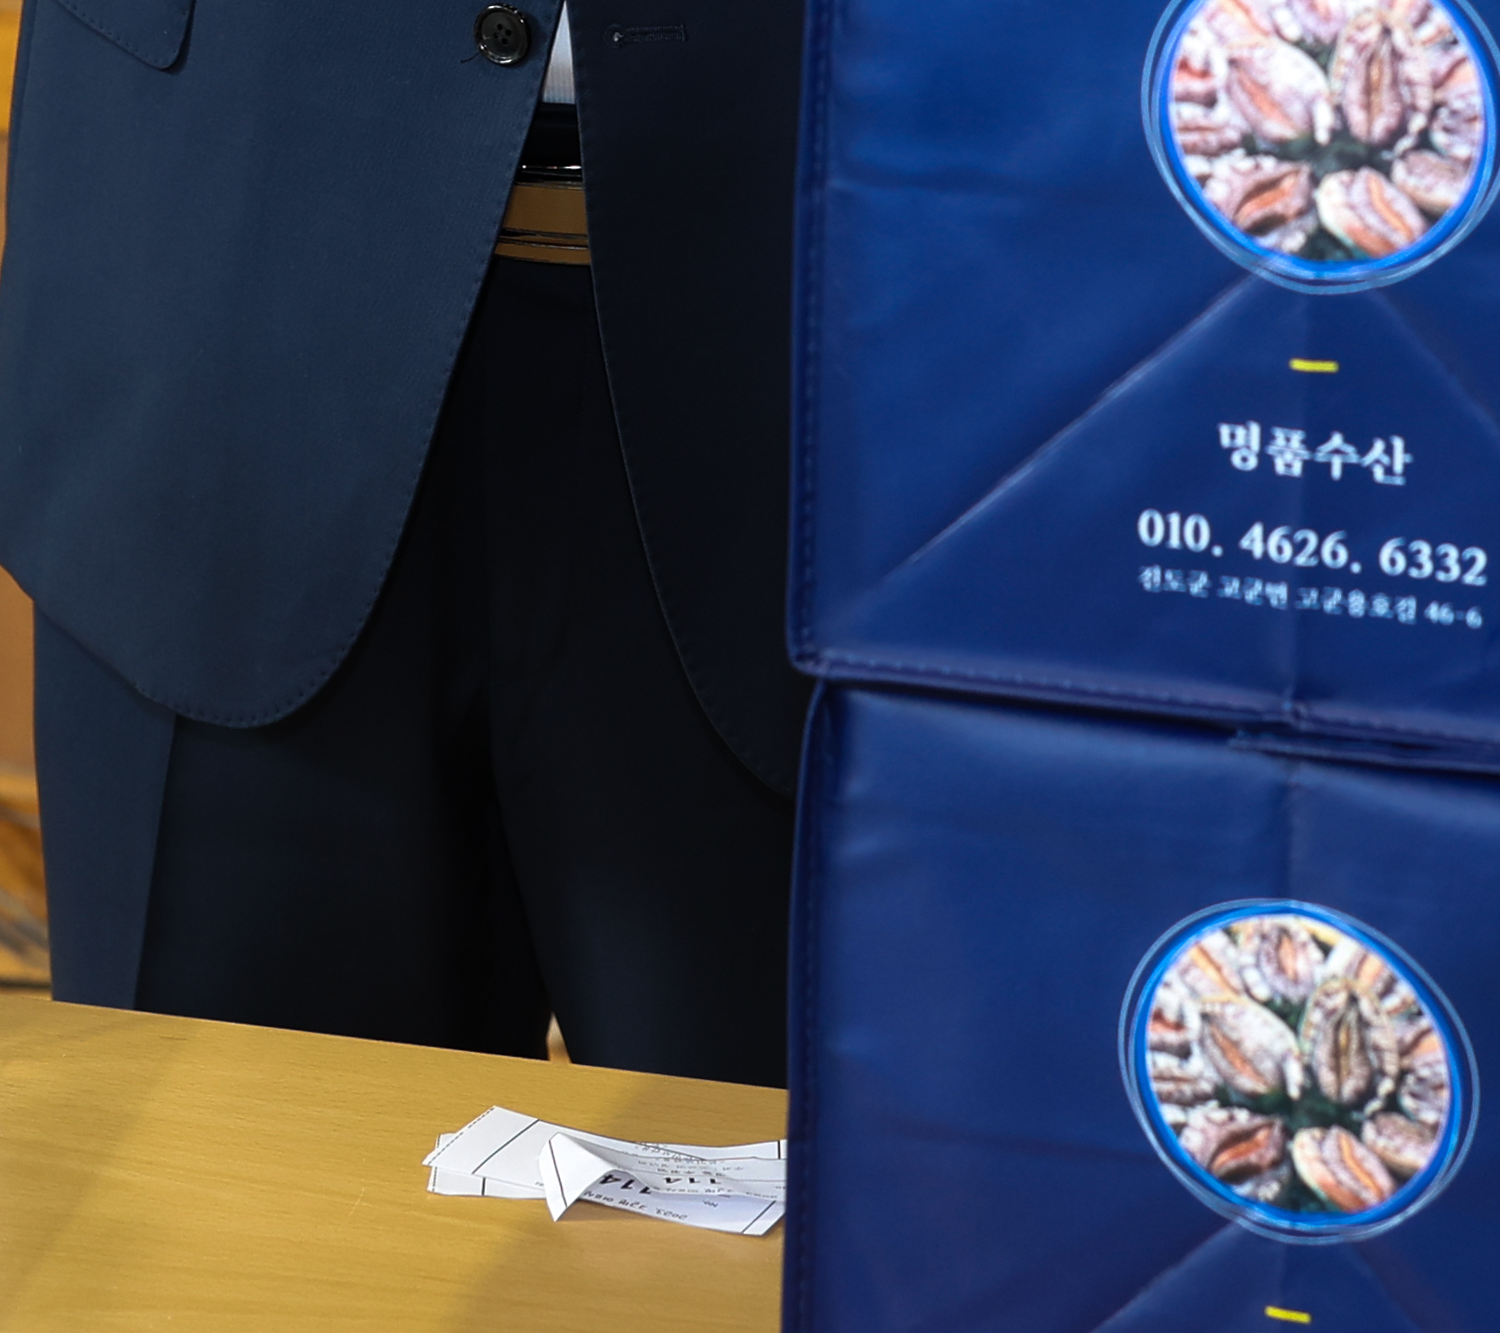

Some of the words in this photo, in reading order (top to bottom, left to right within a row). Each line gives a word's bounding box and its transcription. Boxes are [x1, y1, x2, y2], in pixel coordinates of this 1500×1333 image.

[1217, 419, 1414, 486] 명품수산
[1137, 508, 1224, 558] 010.
[1238, 521, 1363, 575] 4626.
[1378, 537, 1488, 586] 6332
[1138, 564, 1211, 598] 진도군
[1216, 575, 1289, 610] 고군면
[1423, 599, 1483, 629] 46-6
[599, 1173, 653, 1196] 114
